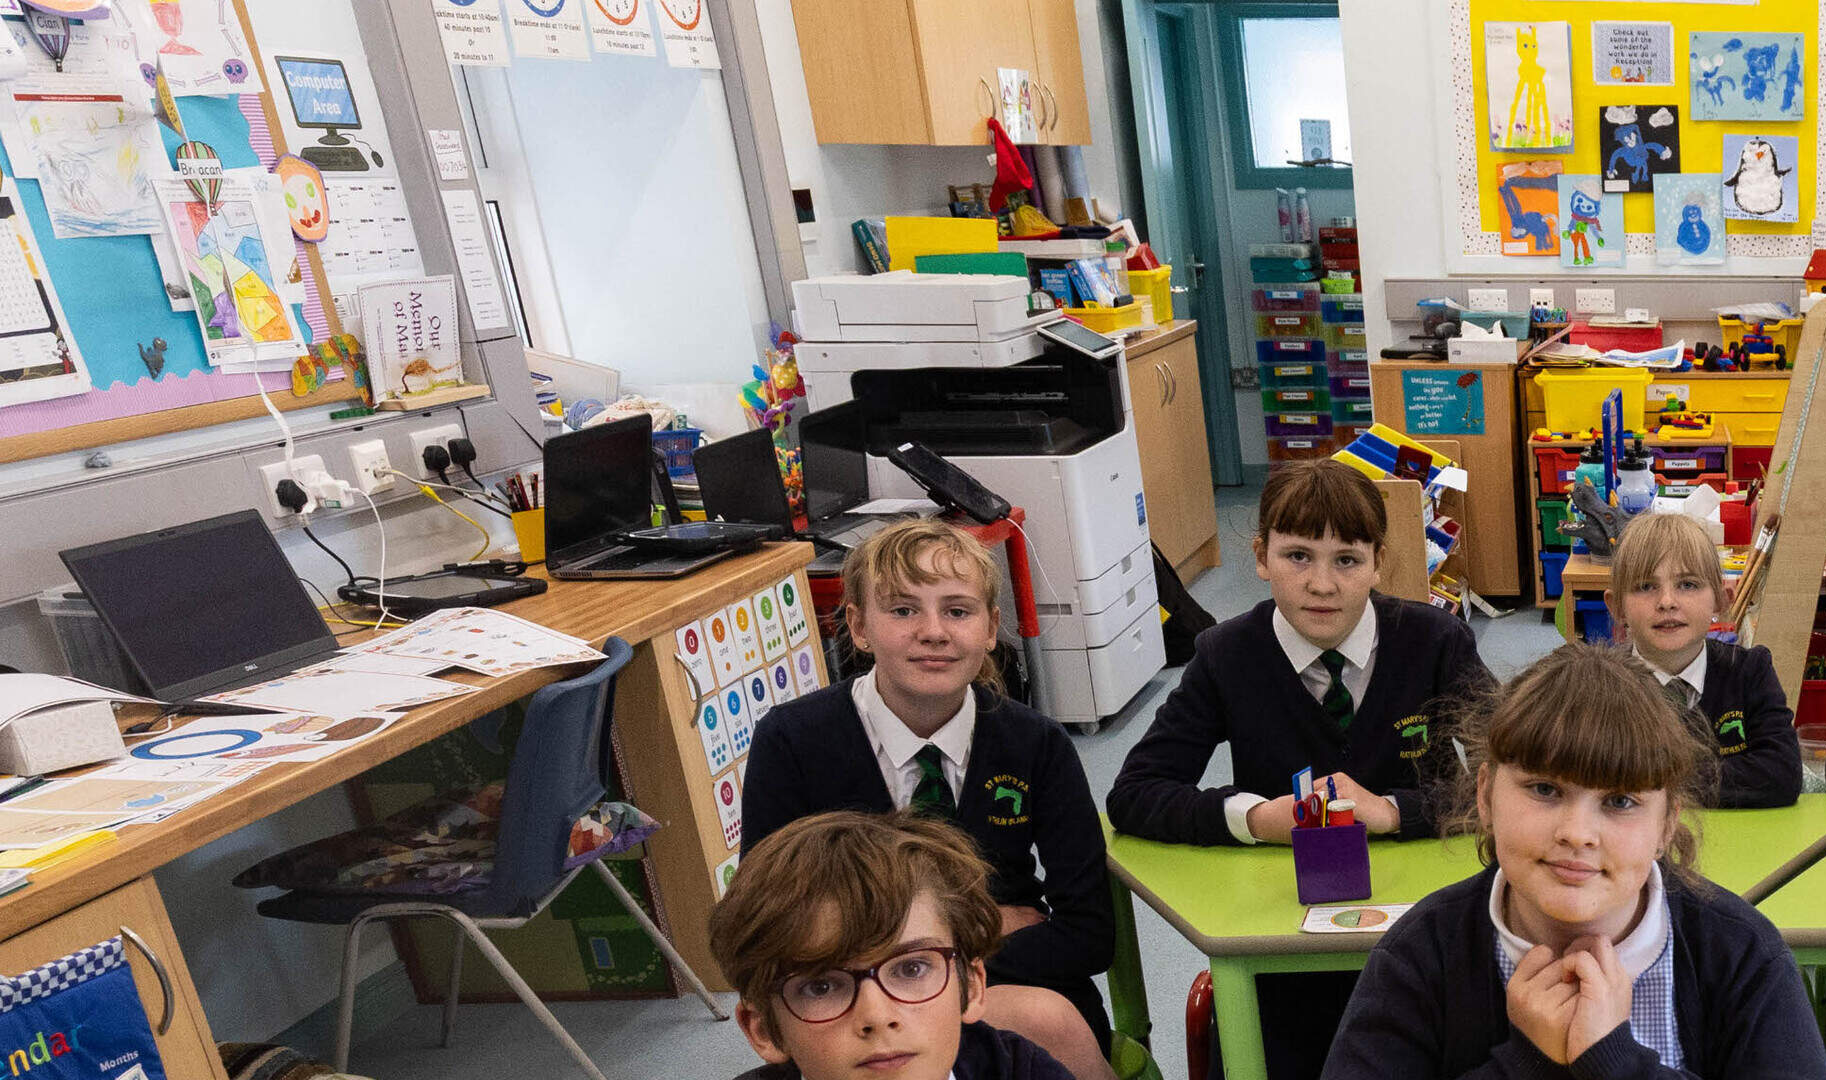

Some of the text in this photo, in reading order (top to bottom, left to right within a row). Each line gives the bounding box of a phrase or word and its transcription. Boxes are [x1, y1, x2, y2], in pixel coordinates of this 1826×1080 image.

[286, 71, 345, 93] Computer
[313, 98, 342, 115] Area
[393, 301, 408, 320] of
[427, 316, 441, 351] Our
[763, 603, 770, 616] 3
[716, 625, 722, 636] 1
[688, 636, 695, 648] 0
[719, 647, 730, 657] one
[755, 683, 762, 696] 7
[730, 697, 738, 709] 6
[707, 711, 714, 724] 5
[722, 787, 732, 800] 10
[99, 1049, 140, 1073] Months
